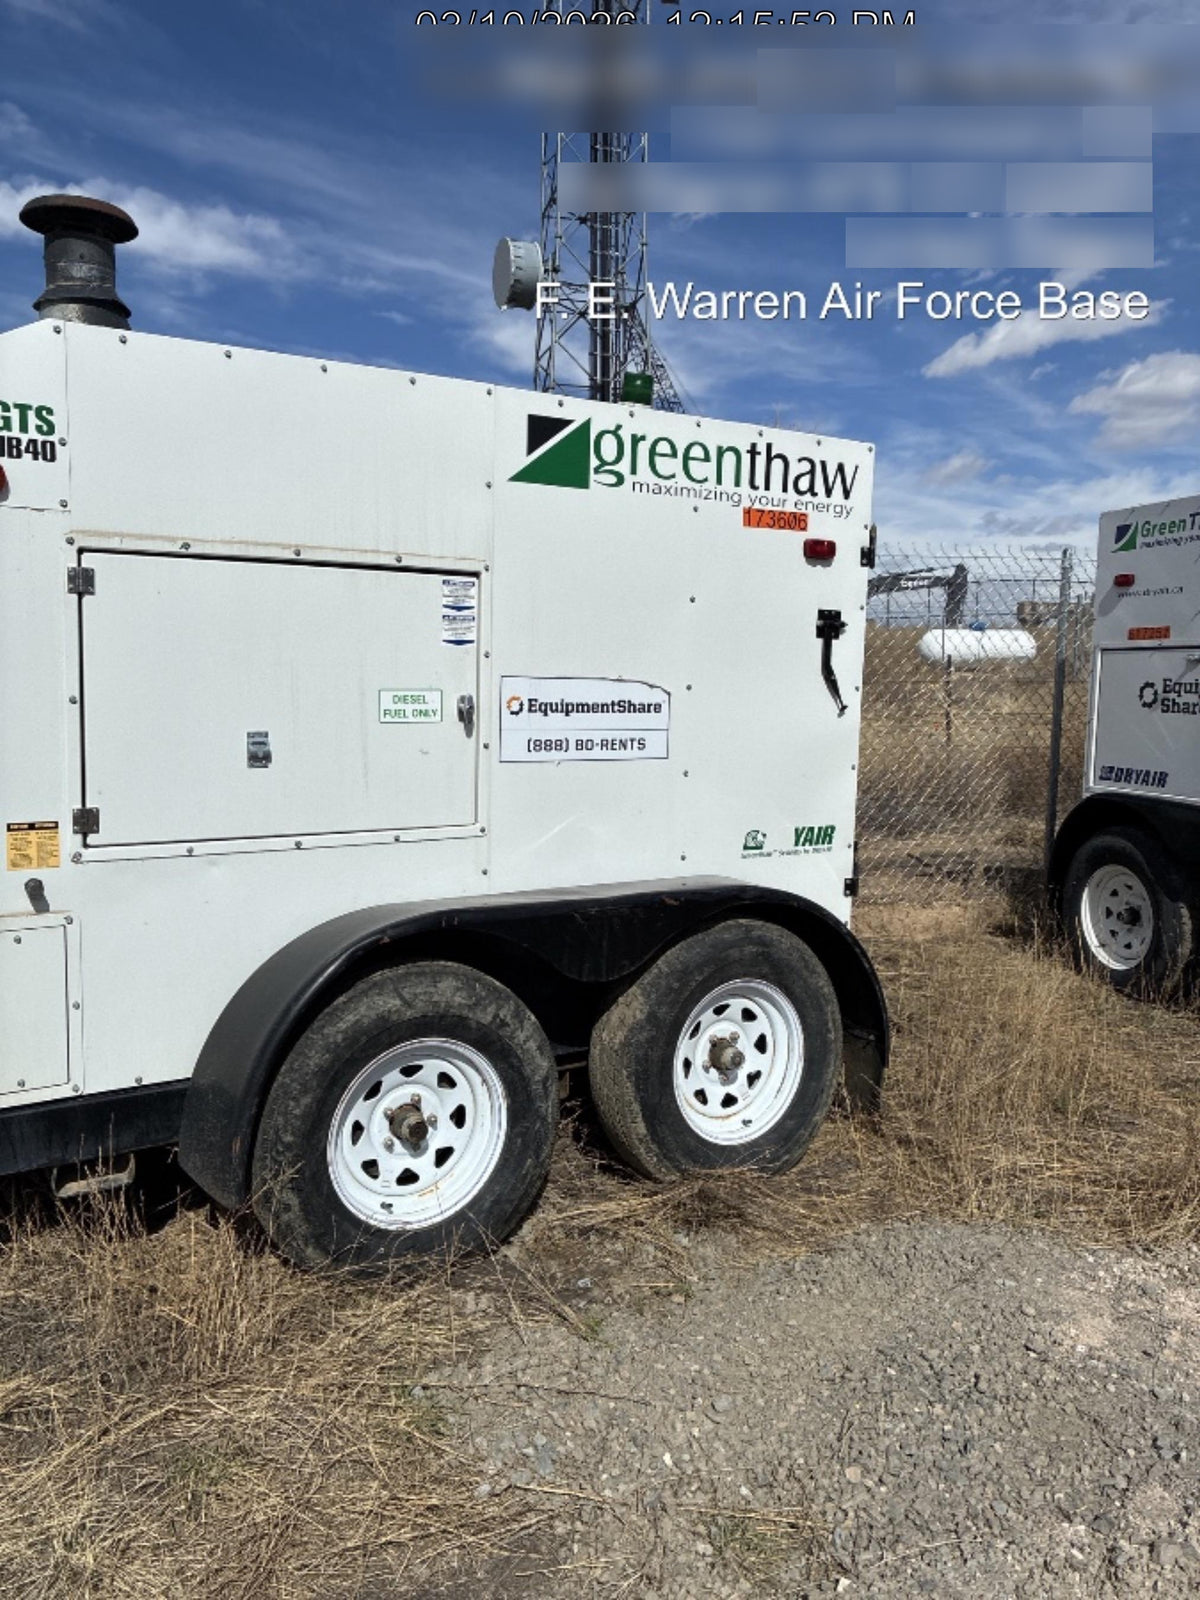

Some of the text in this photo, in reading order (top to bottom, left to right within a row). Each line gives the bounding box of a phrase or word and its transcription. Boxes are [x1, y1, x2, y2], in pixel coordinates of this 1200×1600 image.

[592, 423, 859, 500] greenthaw
[631, 479, 854, 519] maximizing your energy
[742, 507, 809, 531] 173606
[1141, 511, 1200, 538] GreenT
[1162, 678, 1200, 698] Equi
[392, 694, 429, 705] DIESEL
[527, 698, 663, 717] EquipmentShare
[1160, 697, 1200, 715] Shar
[383, 708, 439, 719] FUEL ONLY
[527, 737, 570, 753] (888)
[1113, 766, 1169, 788] DRYAIR
